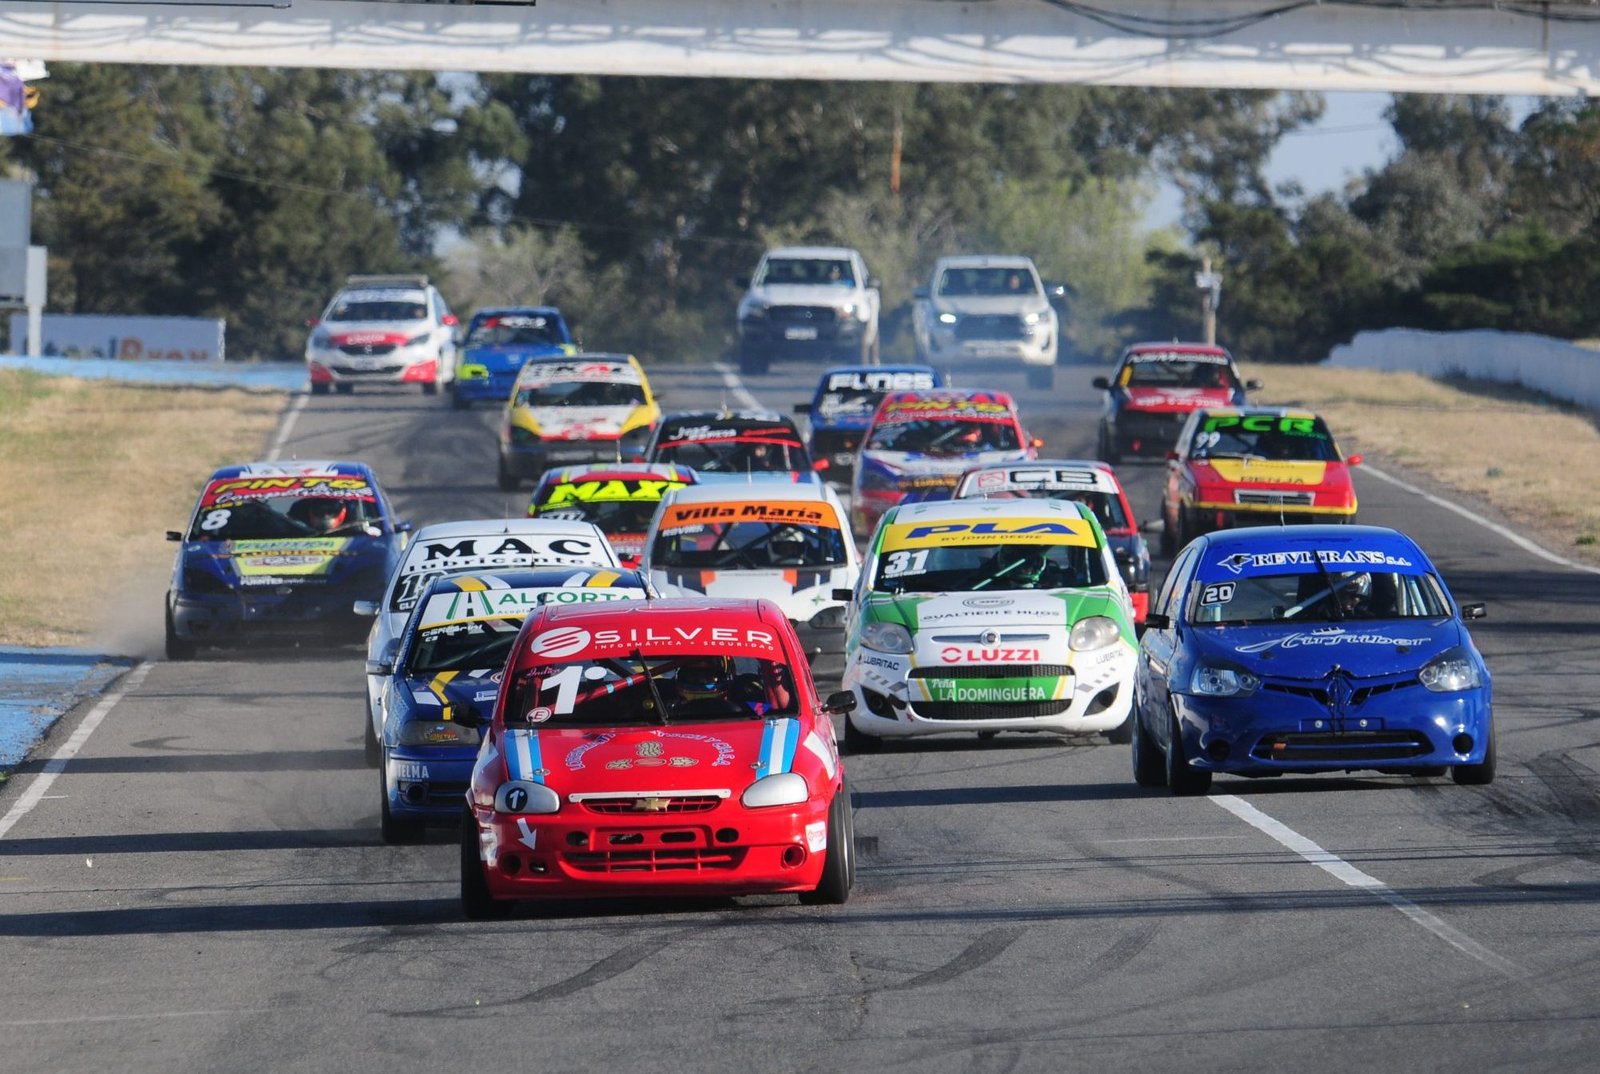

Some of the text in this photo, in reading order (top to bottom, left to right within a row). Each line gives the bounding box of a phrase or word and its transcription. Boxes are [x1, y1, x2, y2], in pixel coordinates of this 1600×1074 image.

[1203, 415, 1316, 432] PCR
[1196, 431, 1221, 449] 99
[210, 477, 367, 494] PINTO
[1009, 470, 1098, 484] CB
[201, 509, 232, 531] 8
[675, 507, 735, 522] Villa
[905, 522, 1078, 539] PLA
[424, 538, 591, 561] MAC
[884, 549, 930, 575] 31
[1205, 585, 1233, 603] 20
[594, 627, 774, 645] SILVER
[703, 641, 775, 651] SEGURIDAD
[863, 653, 900, 671] LUBRITAC
[966, 649, 1040, 662] LUZZI
[939, 687, 1046, 702] LA DOMINGUERA
